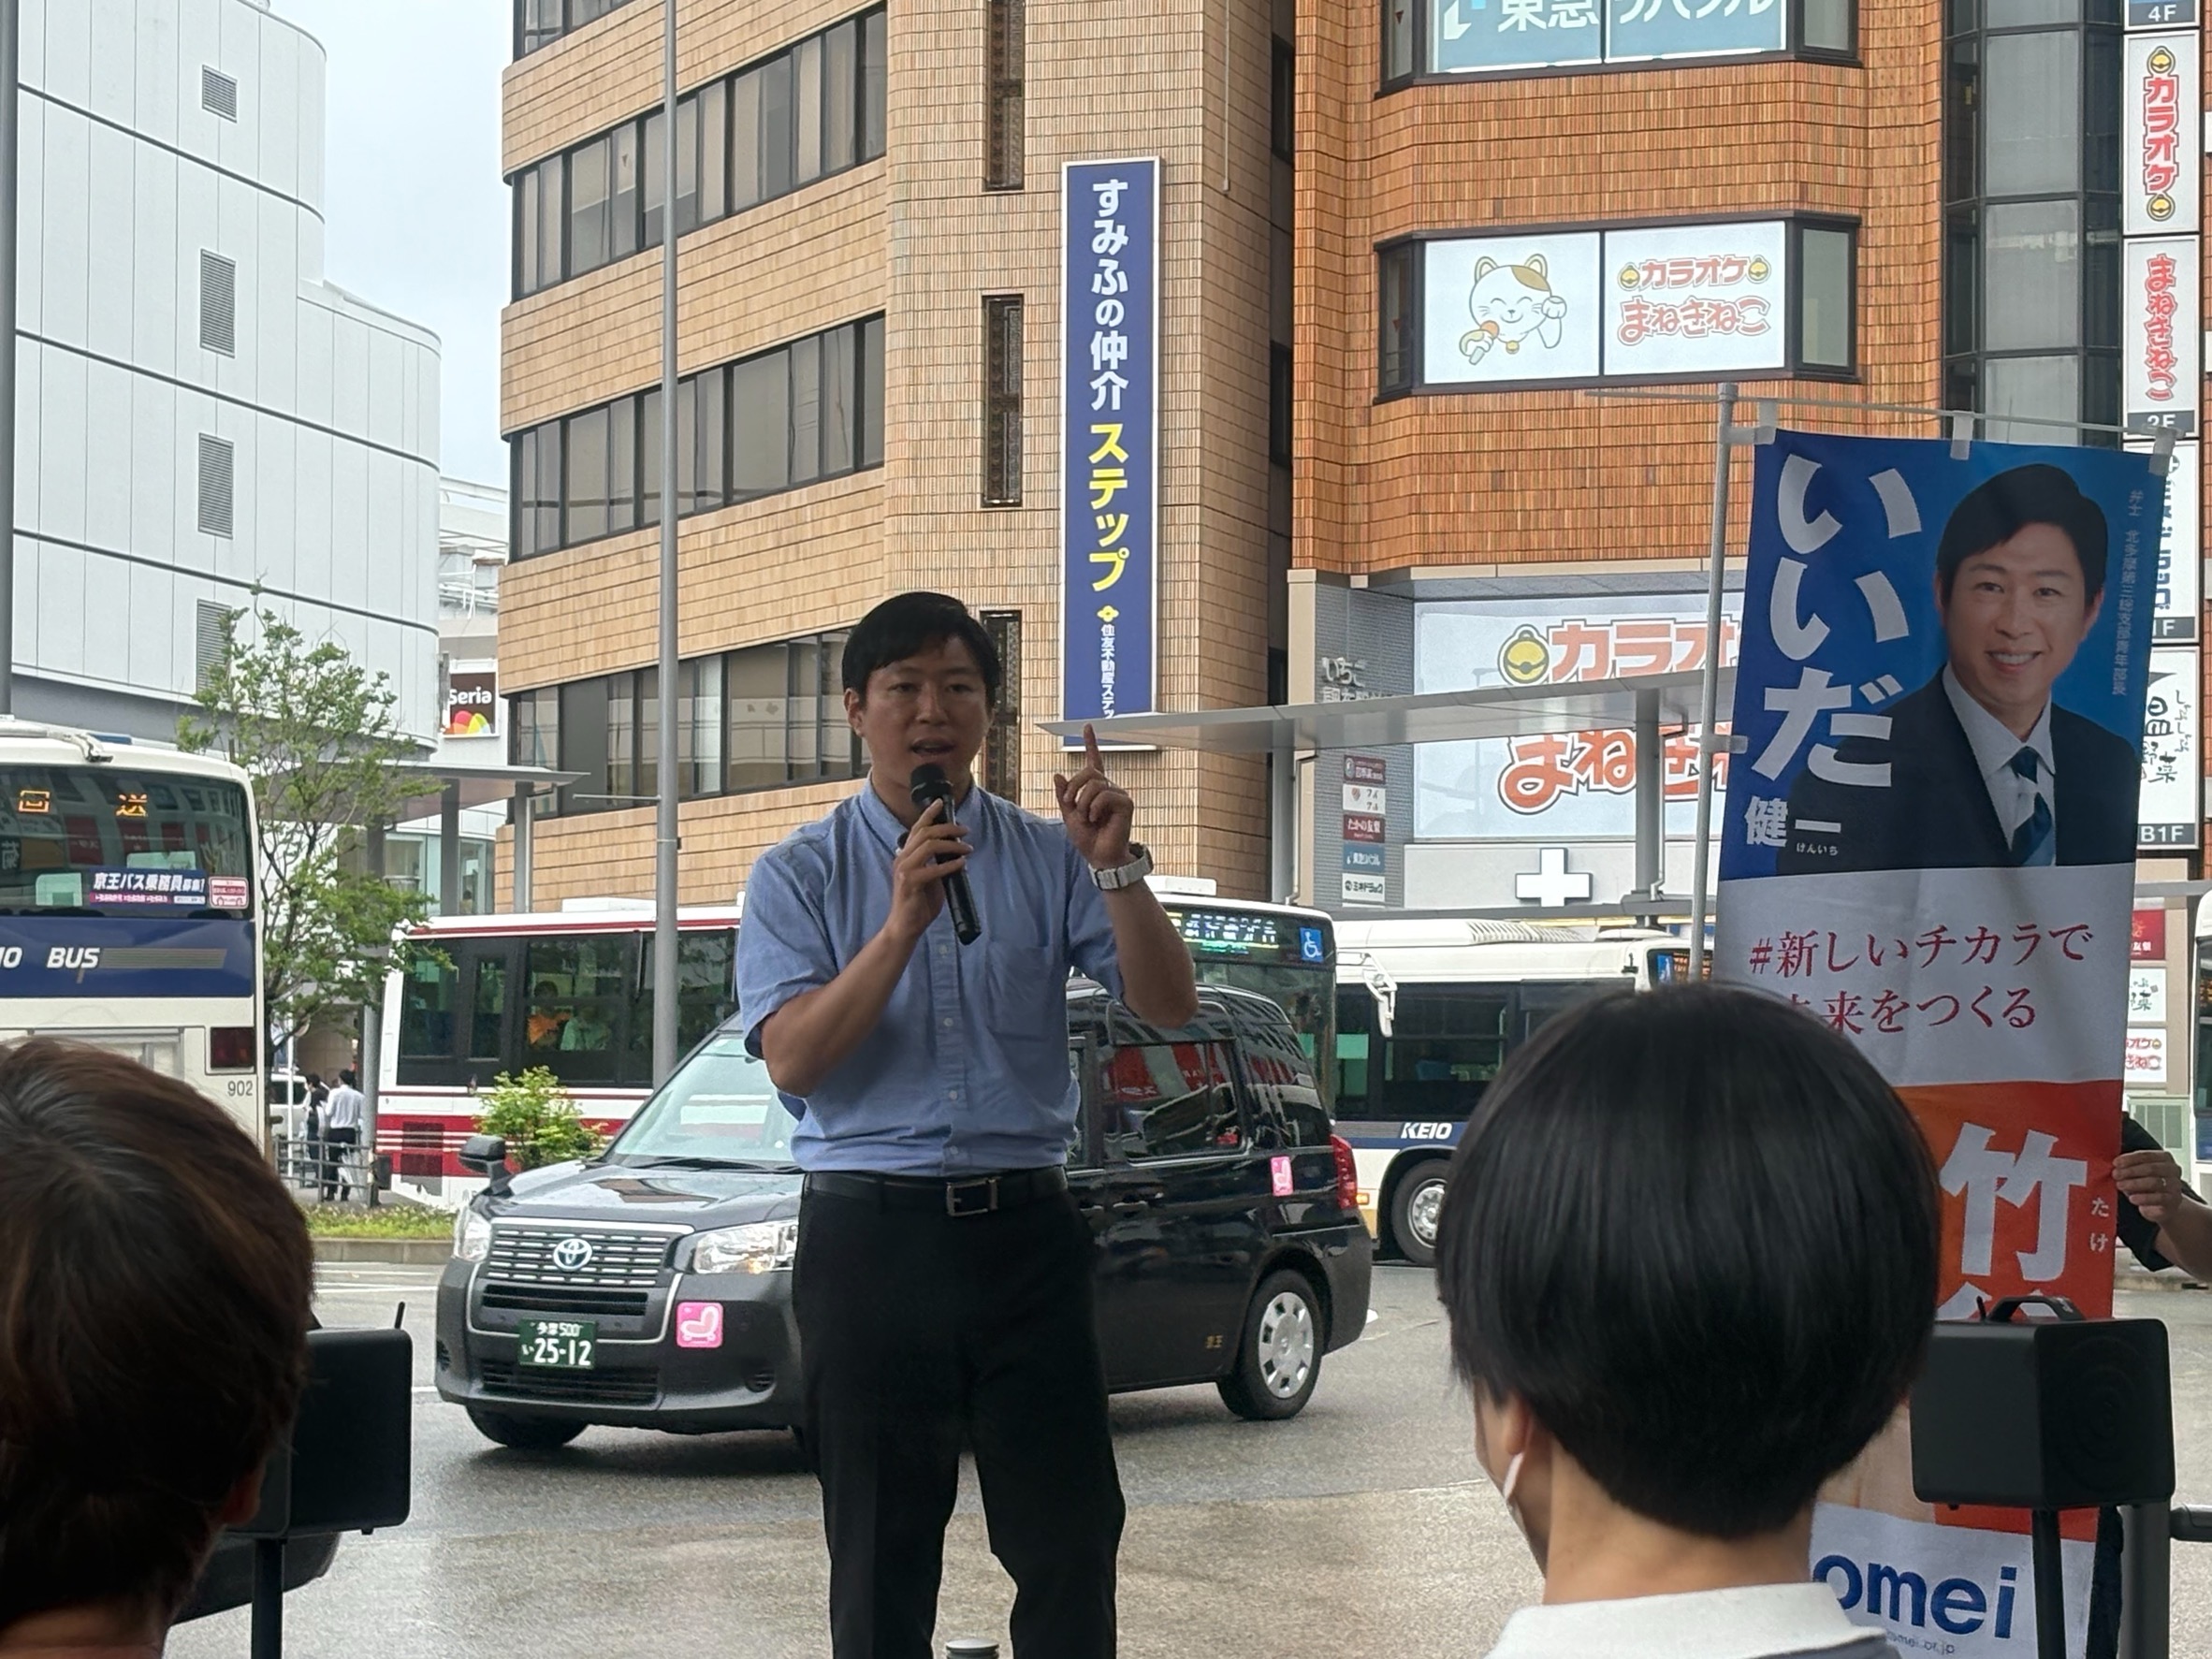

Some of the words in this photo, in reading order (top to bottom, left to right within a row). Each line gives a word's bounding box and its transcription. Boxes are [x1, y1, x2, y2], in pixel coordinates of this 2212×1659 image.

[2148, 5, 2176, 22] 4F
[2144, 74, 2179, 196] カラオケ
[1091, 179, 1128, 412] すみふの仲介
[1640, 255, 1750, 290] カラオケ
[1617, 296, 1772, 346] まねきねこ
[2145, 253, 2177, 402] まねきねこ
[1089, 423, 1129, 591] ステップ
[1752, 453, 1922, 788] いいだ
[1100, 623, 1115, 719] 住友不動産ステッ
[1546, 619, 1742, 683] カラオ
[449, 686, 492, 705] Seria
[1744, 795, 1841, 847] 健一
[2140, 826, 2184, 841] B1F
[1797, 842, 1839, 856] けんいち
[47, 947, 100, 968] BUS
[1749, 924, 2093, 978] #新しいチカラで
[227, 1080, 254, 1097] 902
[1401, 1123, 1452, 1140] KEIO
[534, 1337, 591, 1365] 25-12
[1812, 1554, 2017, 1638] omei
